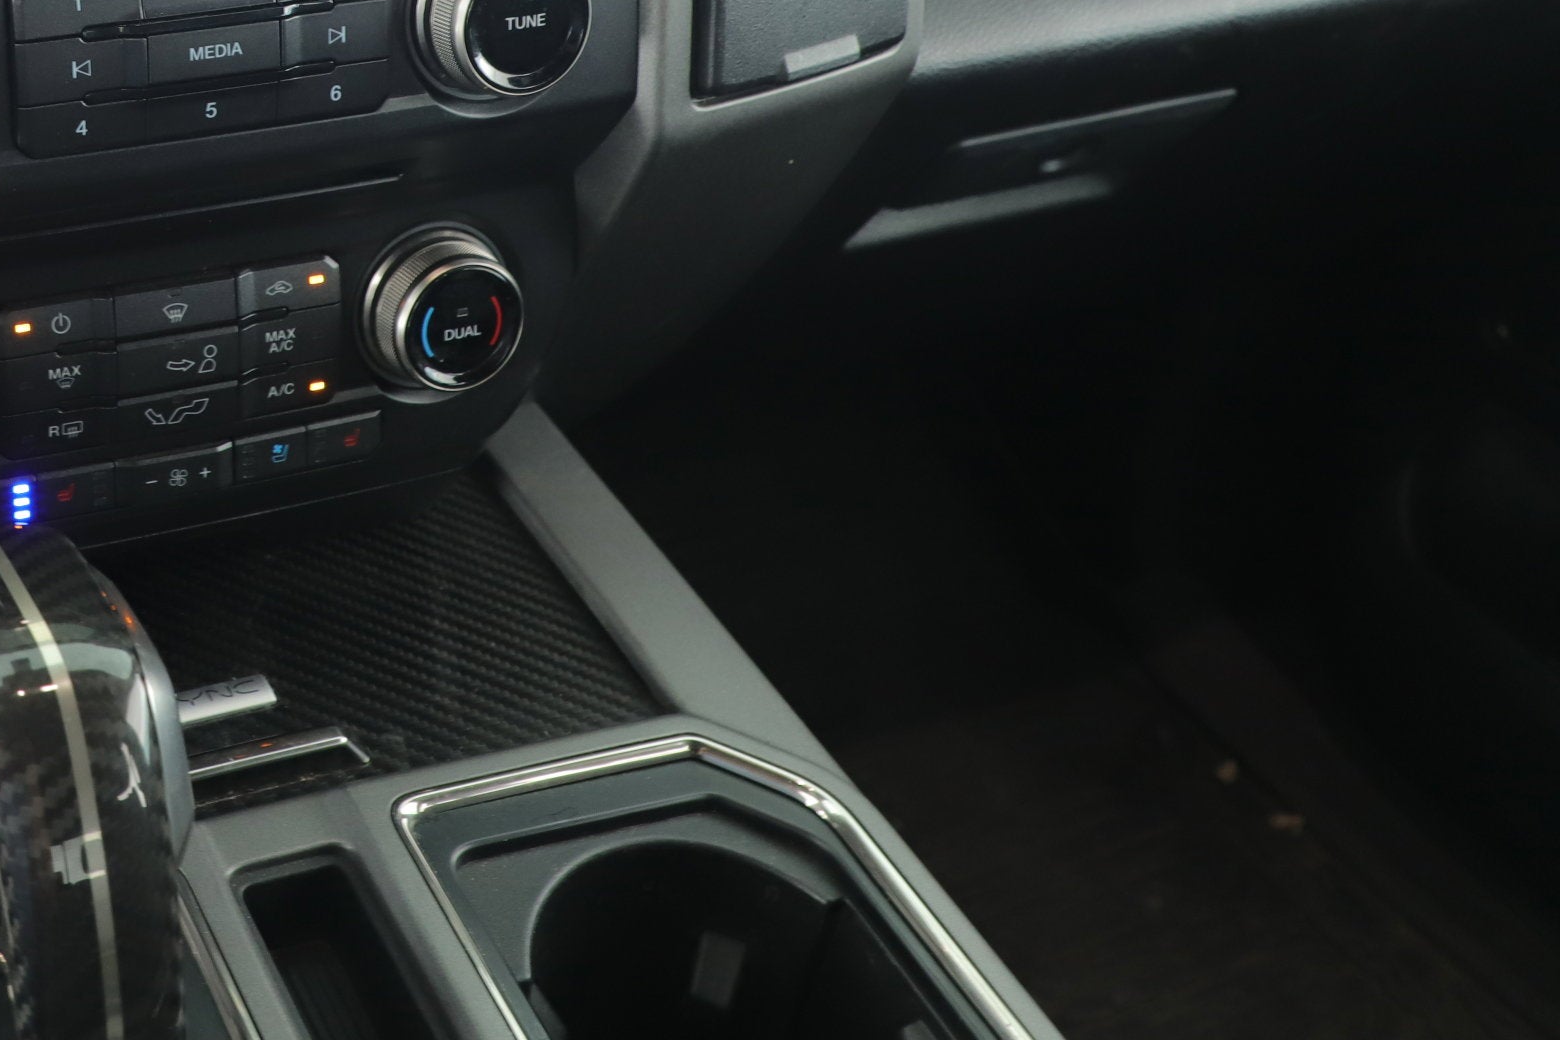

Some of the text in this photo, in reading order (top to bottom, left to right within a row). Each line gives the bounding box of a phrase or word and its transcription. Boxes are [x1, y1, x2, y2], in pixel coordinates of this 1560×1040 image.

[505, 13, 547, 30] TUNE
[189, 41, 243, 61] MEDIA
[330, 84, 342, 101] 6
[205, 102, 217, 119] 5
[75, 120, 88, 136] 4
[265, 328, 296, 343] MAX
[444, 327, 482, 342] DUAL
[269, 340, 293, 354] A/C
[48, 365, 82, 380] MAX
[267, 383, 295, 399] A/C
[48, 425, 60, 437] R
